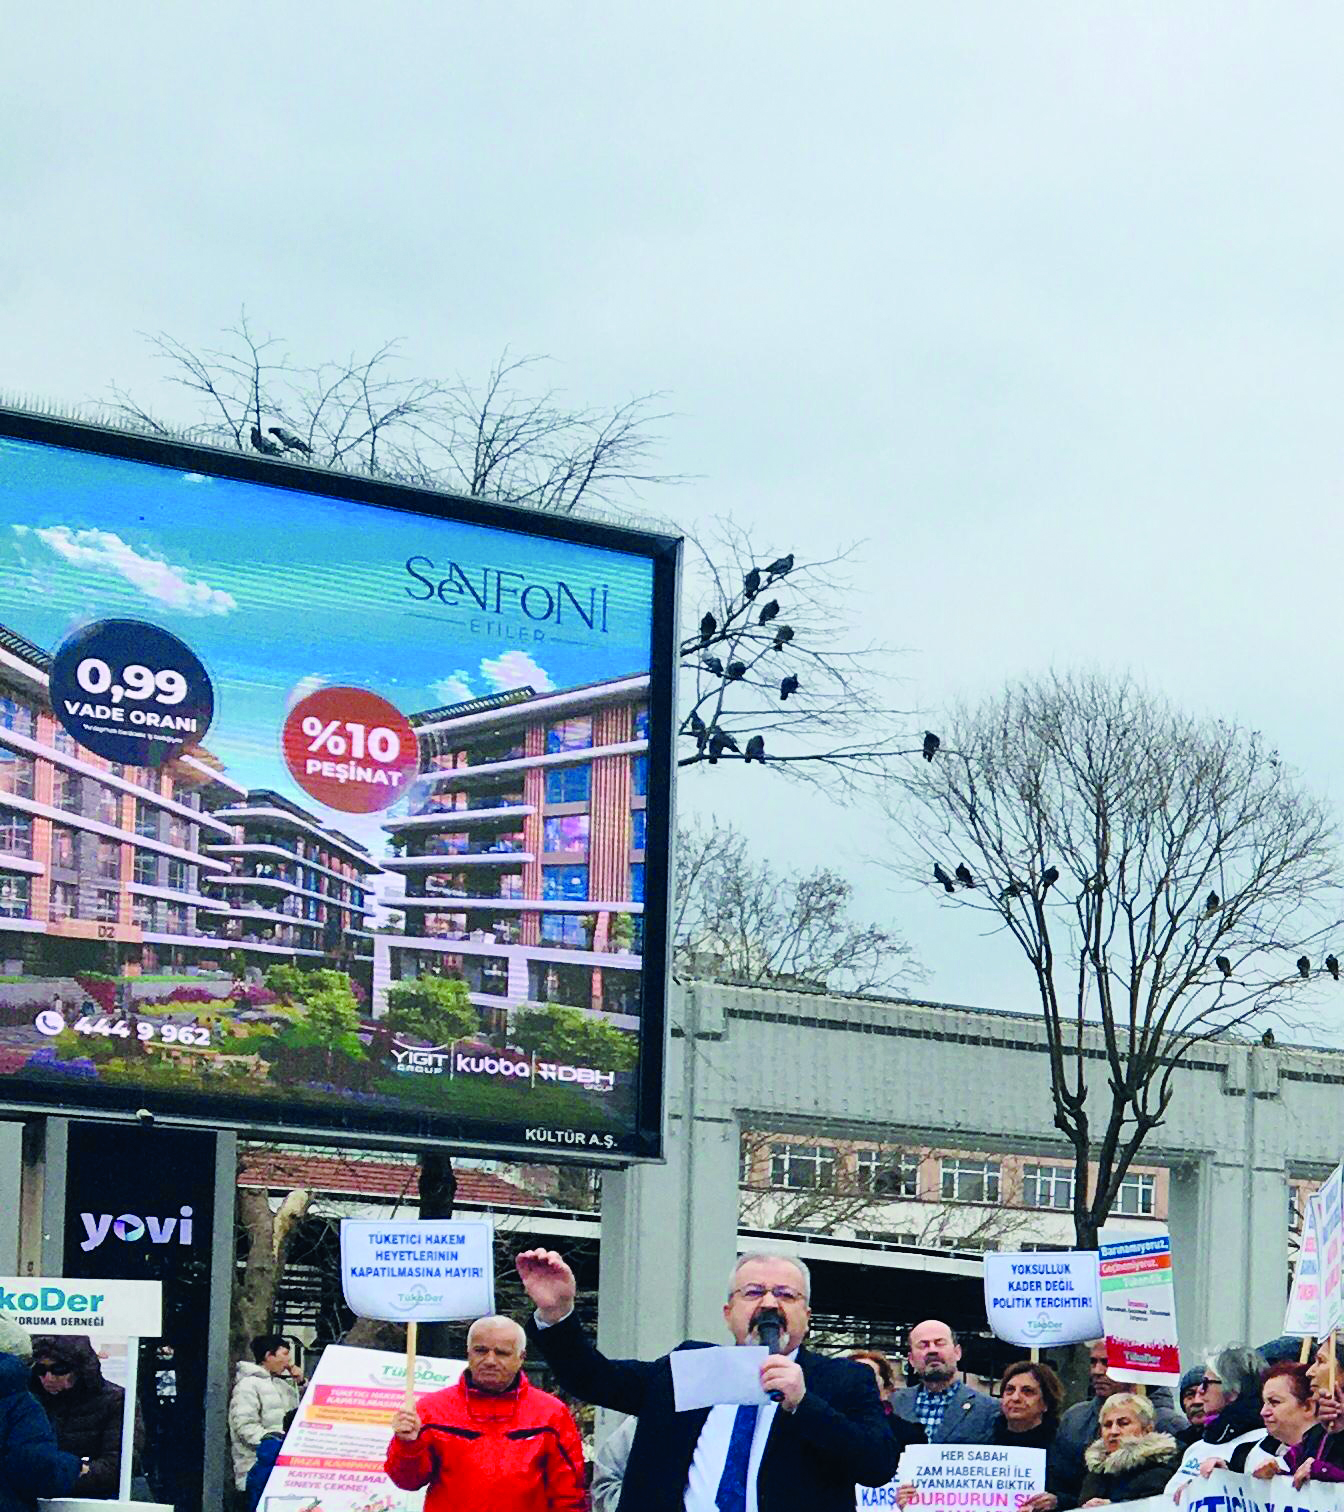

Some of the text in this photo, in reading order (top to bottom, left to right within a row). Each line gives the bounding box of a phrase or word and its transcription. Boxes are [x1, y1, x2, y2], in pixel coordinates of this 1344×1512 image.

[76, 658, 188, 704] 0,99
[63, 700, 197, 733] VADE ORANI
[301, 716, 400, 763] %10
[306, 759, 402, 787] PEŞİNAT
[74, 1016, 211, 1046] 444 9 962
[457, 1054, 530, 1077] kubba
[525, 1127, 619, 1149] KÜLTÜR A.Ş.
[80, 1205, 194, 1252] yovi
[368, 1232, 466, 1245] TÜKETİCİ HAKEM
[375, 1249, 459, 1262] HEYETLERİNİN
[350, 1266, 484, 1278] KAPATILMASINA HAYIR!
[1010, 1263, 1072, 1275] YOKSULLUK
[1007, 1278, 1075, 1292] KADER DEĞİL
[0, 1286, 105, 1313] koDer
[14, 1316, 105, 1327] ORUMA DERNEĞİ
[381, 1364, 450, 1383] TüoDer
[940, 1450, 1009, 1462] HER SABAH
[916, 1464, 1033, 1479] ZAM HABERLERİ İLE
[996, 1479, 1036, 1491] BIKTIK
[861, 1487, 897, 1511] KARŞ
